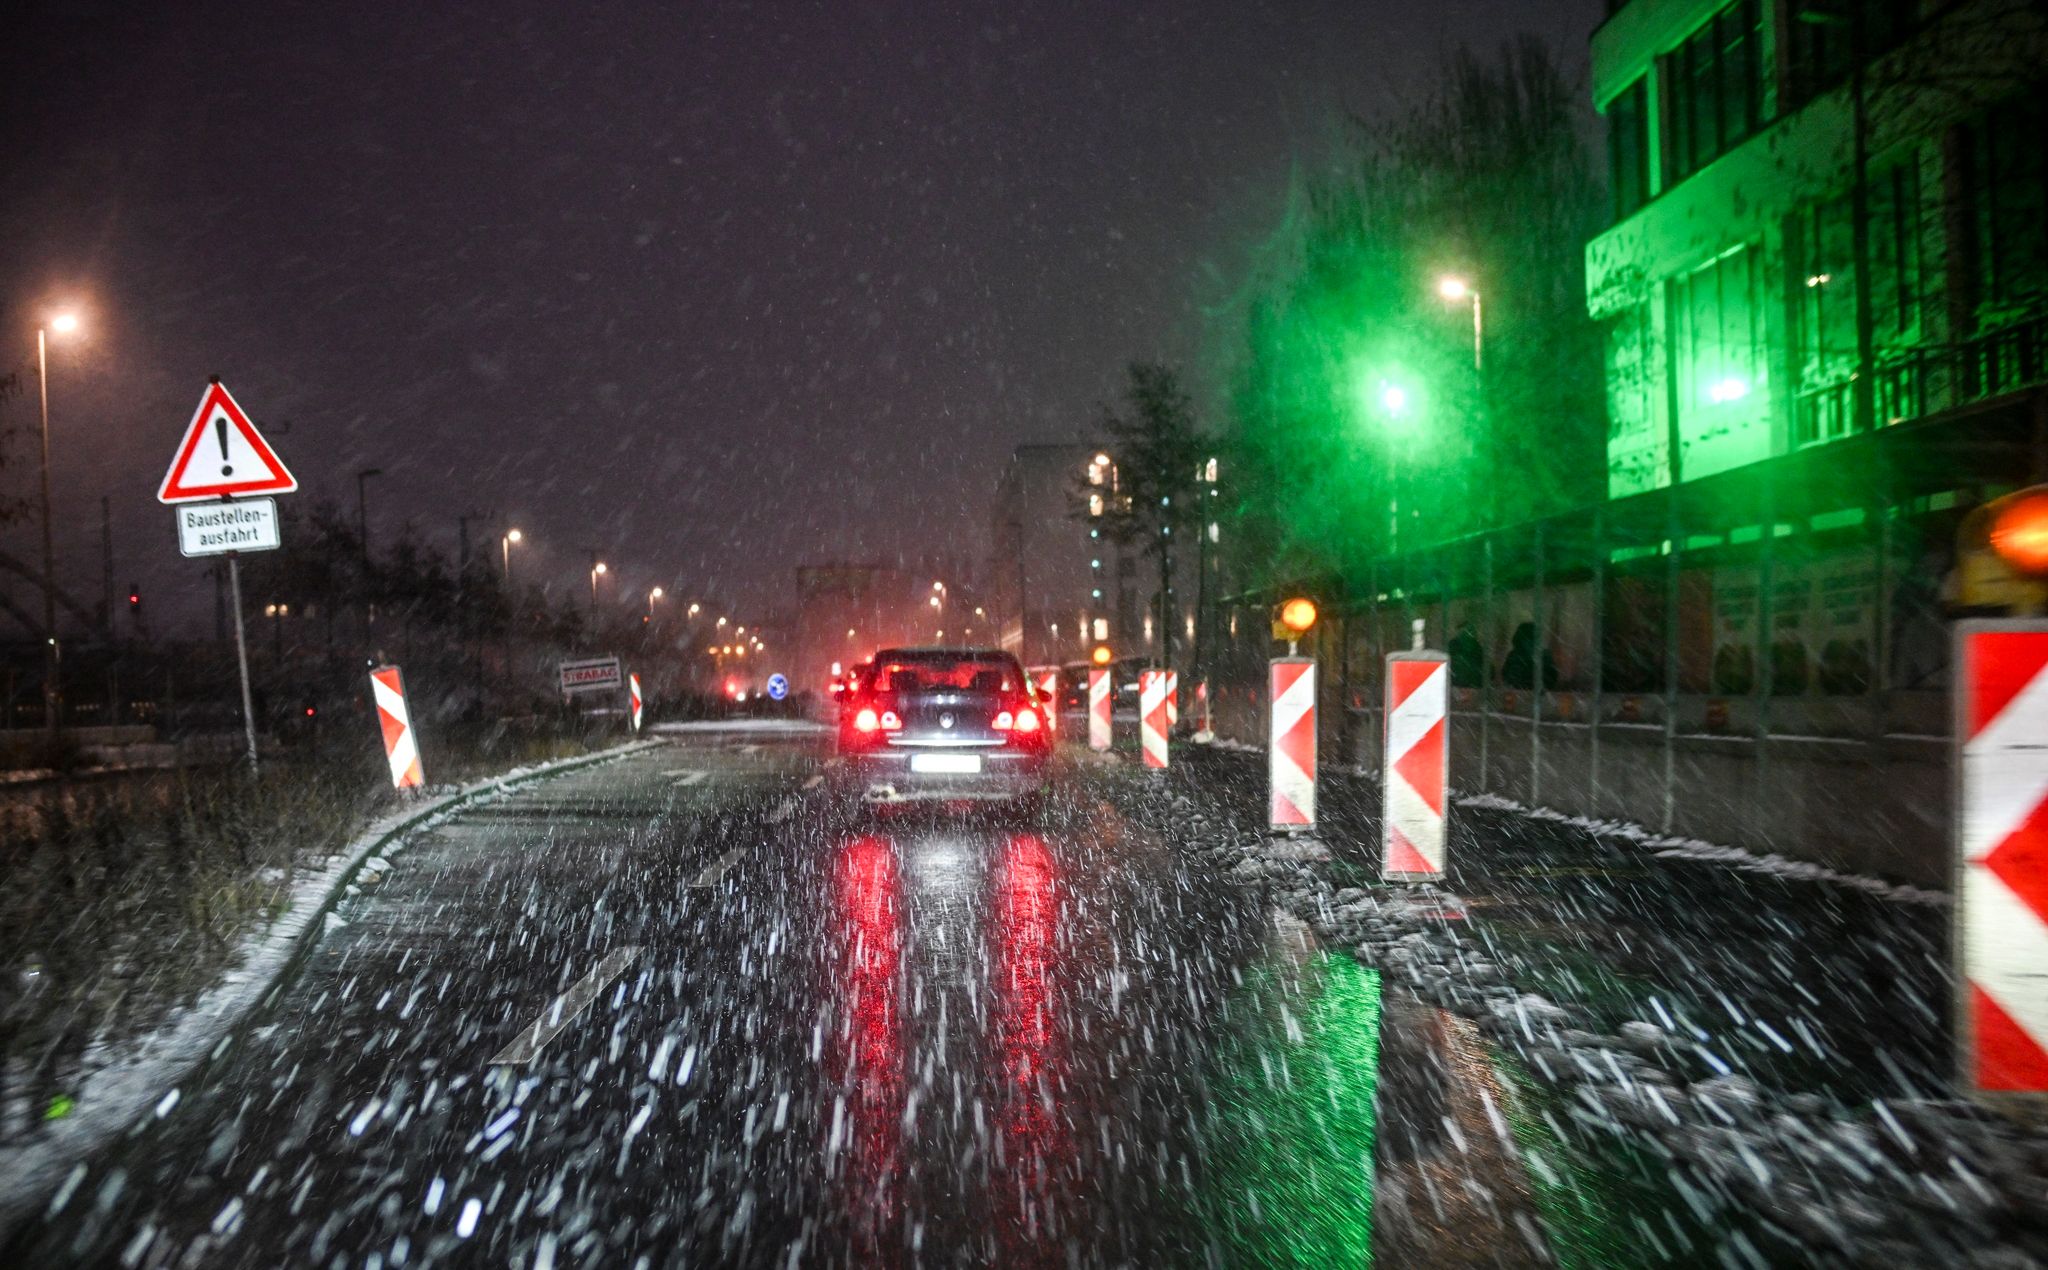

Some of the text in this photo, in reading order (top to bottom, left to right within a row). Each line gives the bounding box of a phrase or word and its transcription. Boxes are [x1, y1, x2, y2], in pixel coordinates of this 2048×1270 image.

[187, 508, 268, 528] Baustellen-
[200, 526, 259, 546] ausfahrt
[563, 667, 617, 683] STRABAG
